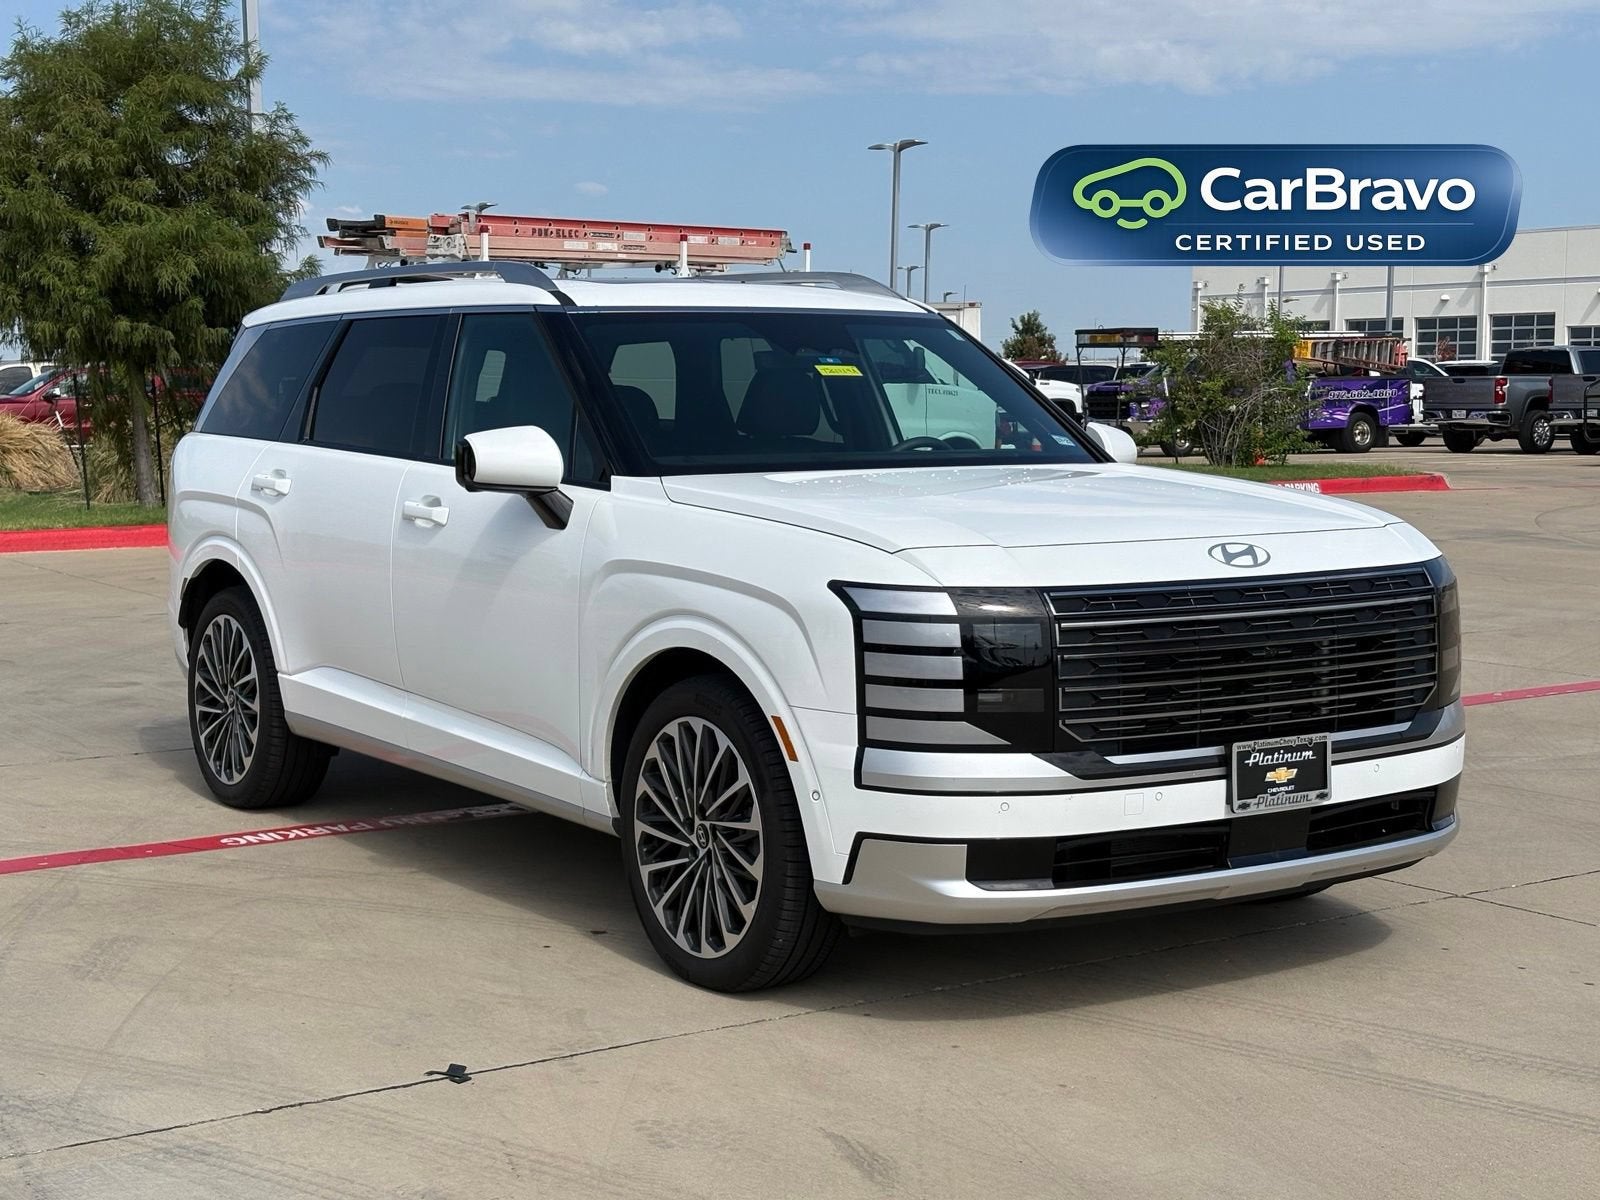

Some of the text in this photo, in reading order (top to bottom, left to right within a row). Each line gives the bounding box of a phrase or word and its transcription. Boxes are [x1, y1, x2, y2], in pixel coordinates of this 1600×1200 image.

[1236, 734, 1328, 751] www.PlatinumChevyTexas.com
[1244, 749, 1317, 767] Platinum
[1267, 785, 1295, 794] CHEVROLET
[1253, 792, 1313, 809] Platinum
[220, 821, 374, 847] PARKING
